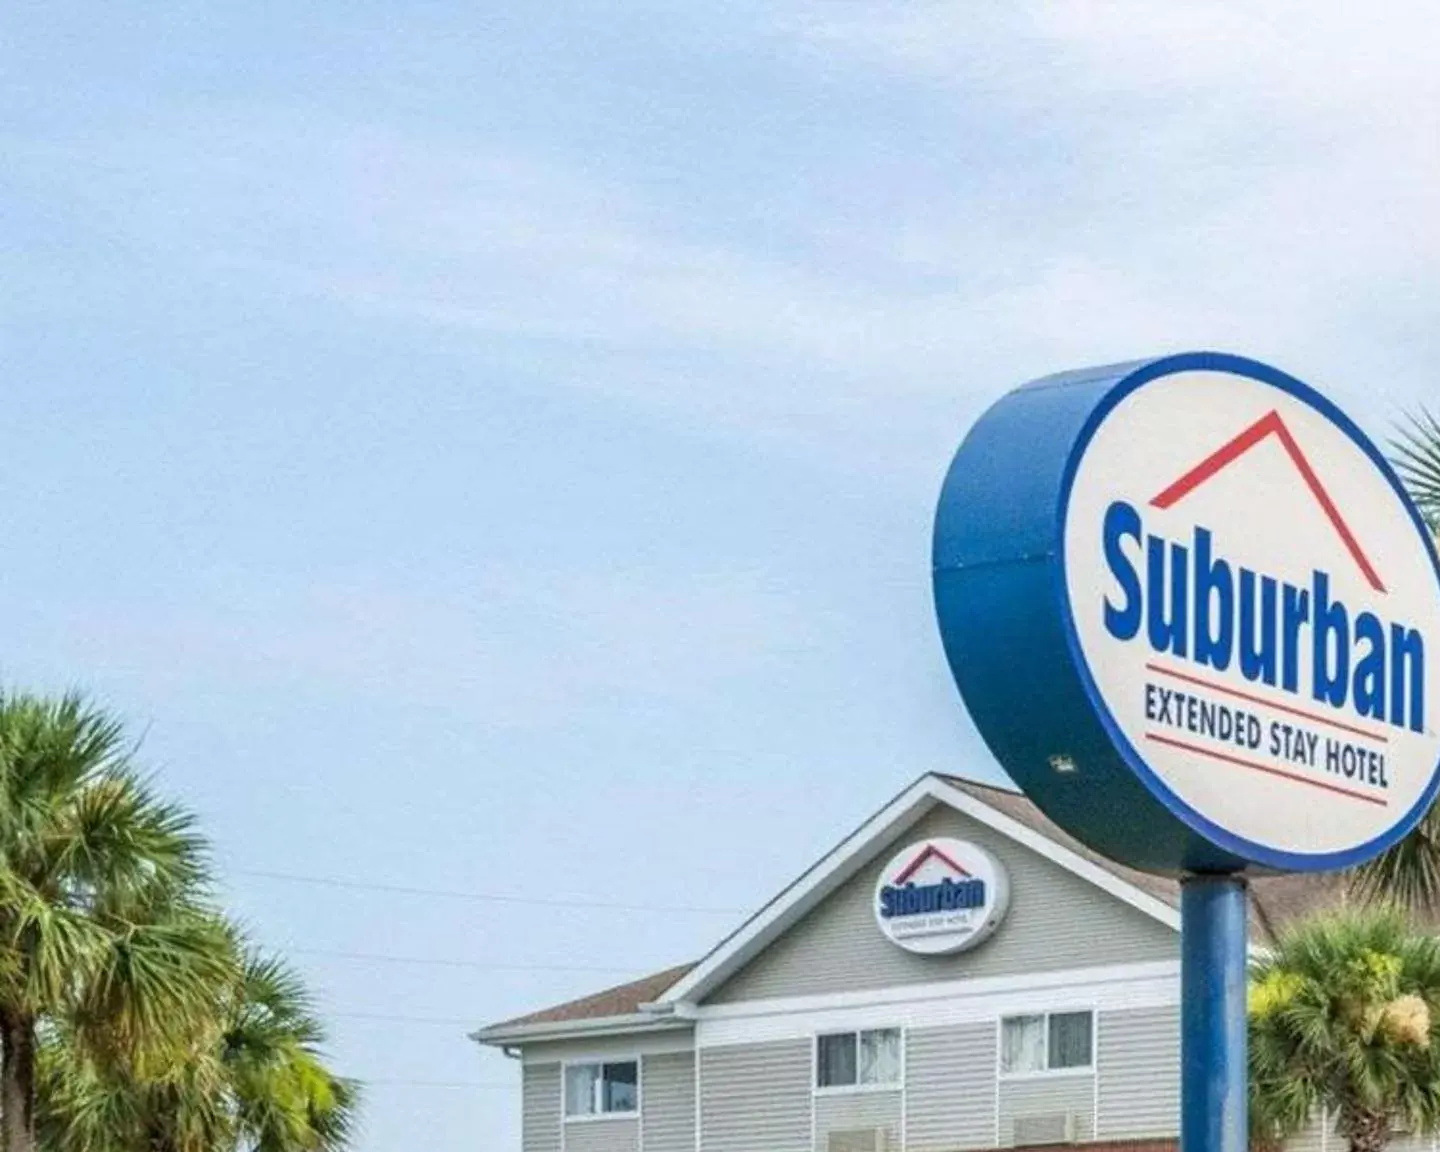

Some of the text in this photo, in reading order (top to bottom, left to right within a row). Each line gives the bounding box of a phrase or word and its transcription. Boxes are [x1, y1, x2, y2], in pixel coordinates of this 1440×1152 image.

[1103, 500, 1424, 734] Suburban
[1145, 683, 1388, 788] EXTENDED STAY HOTEL
